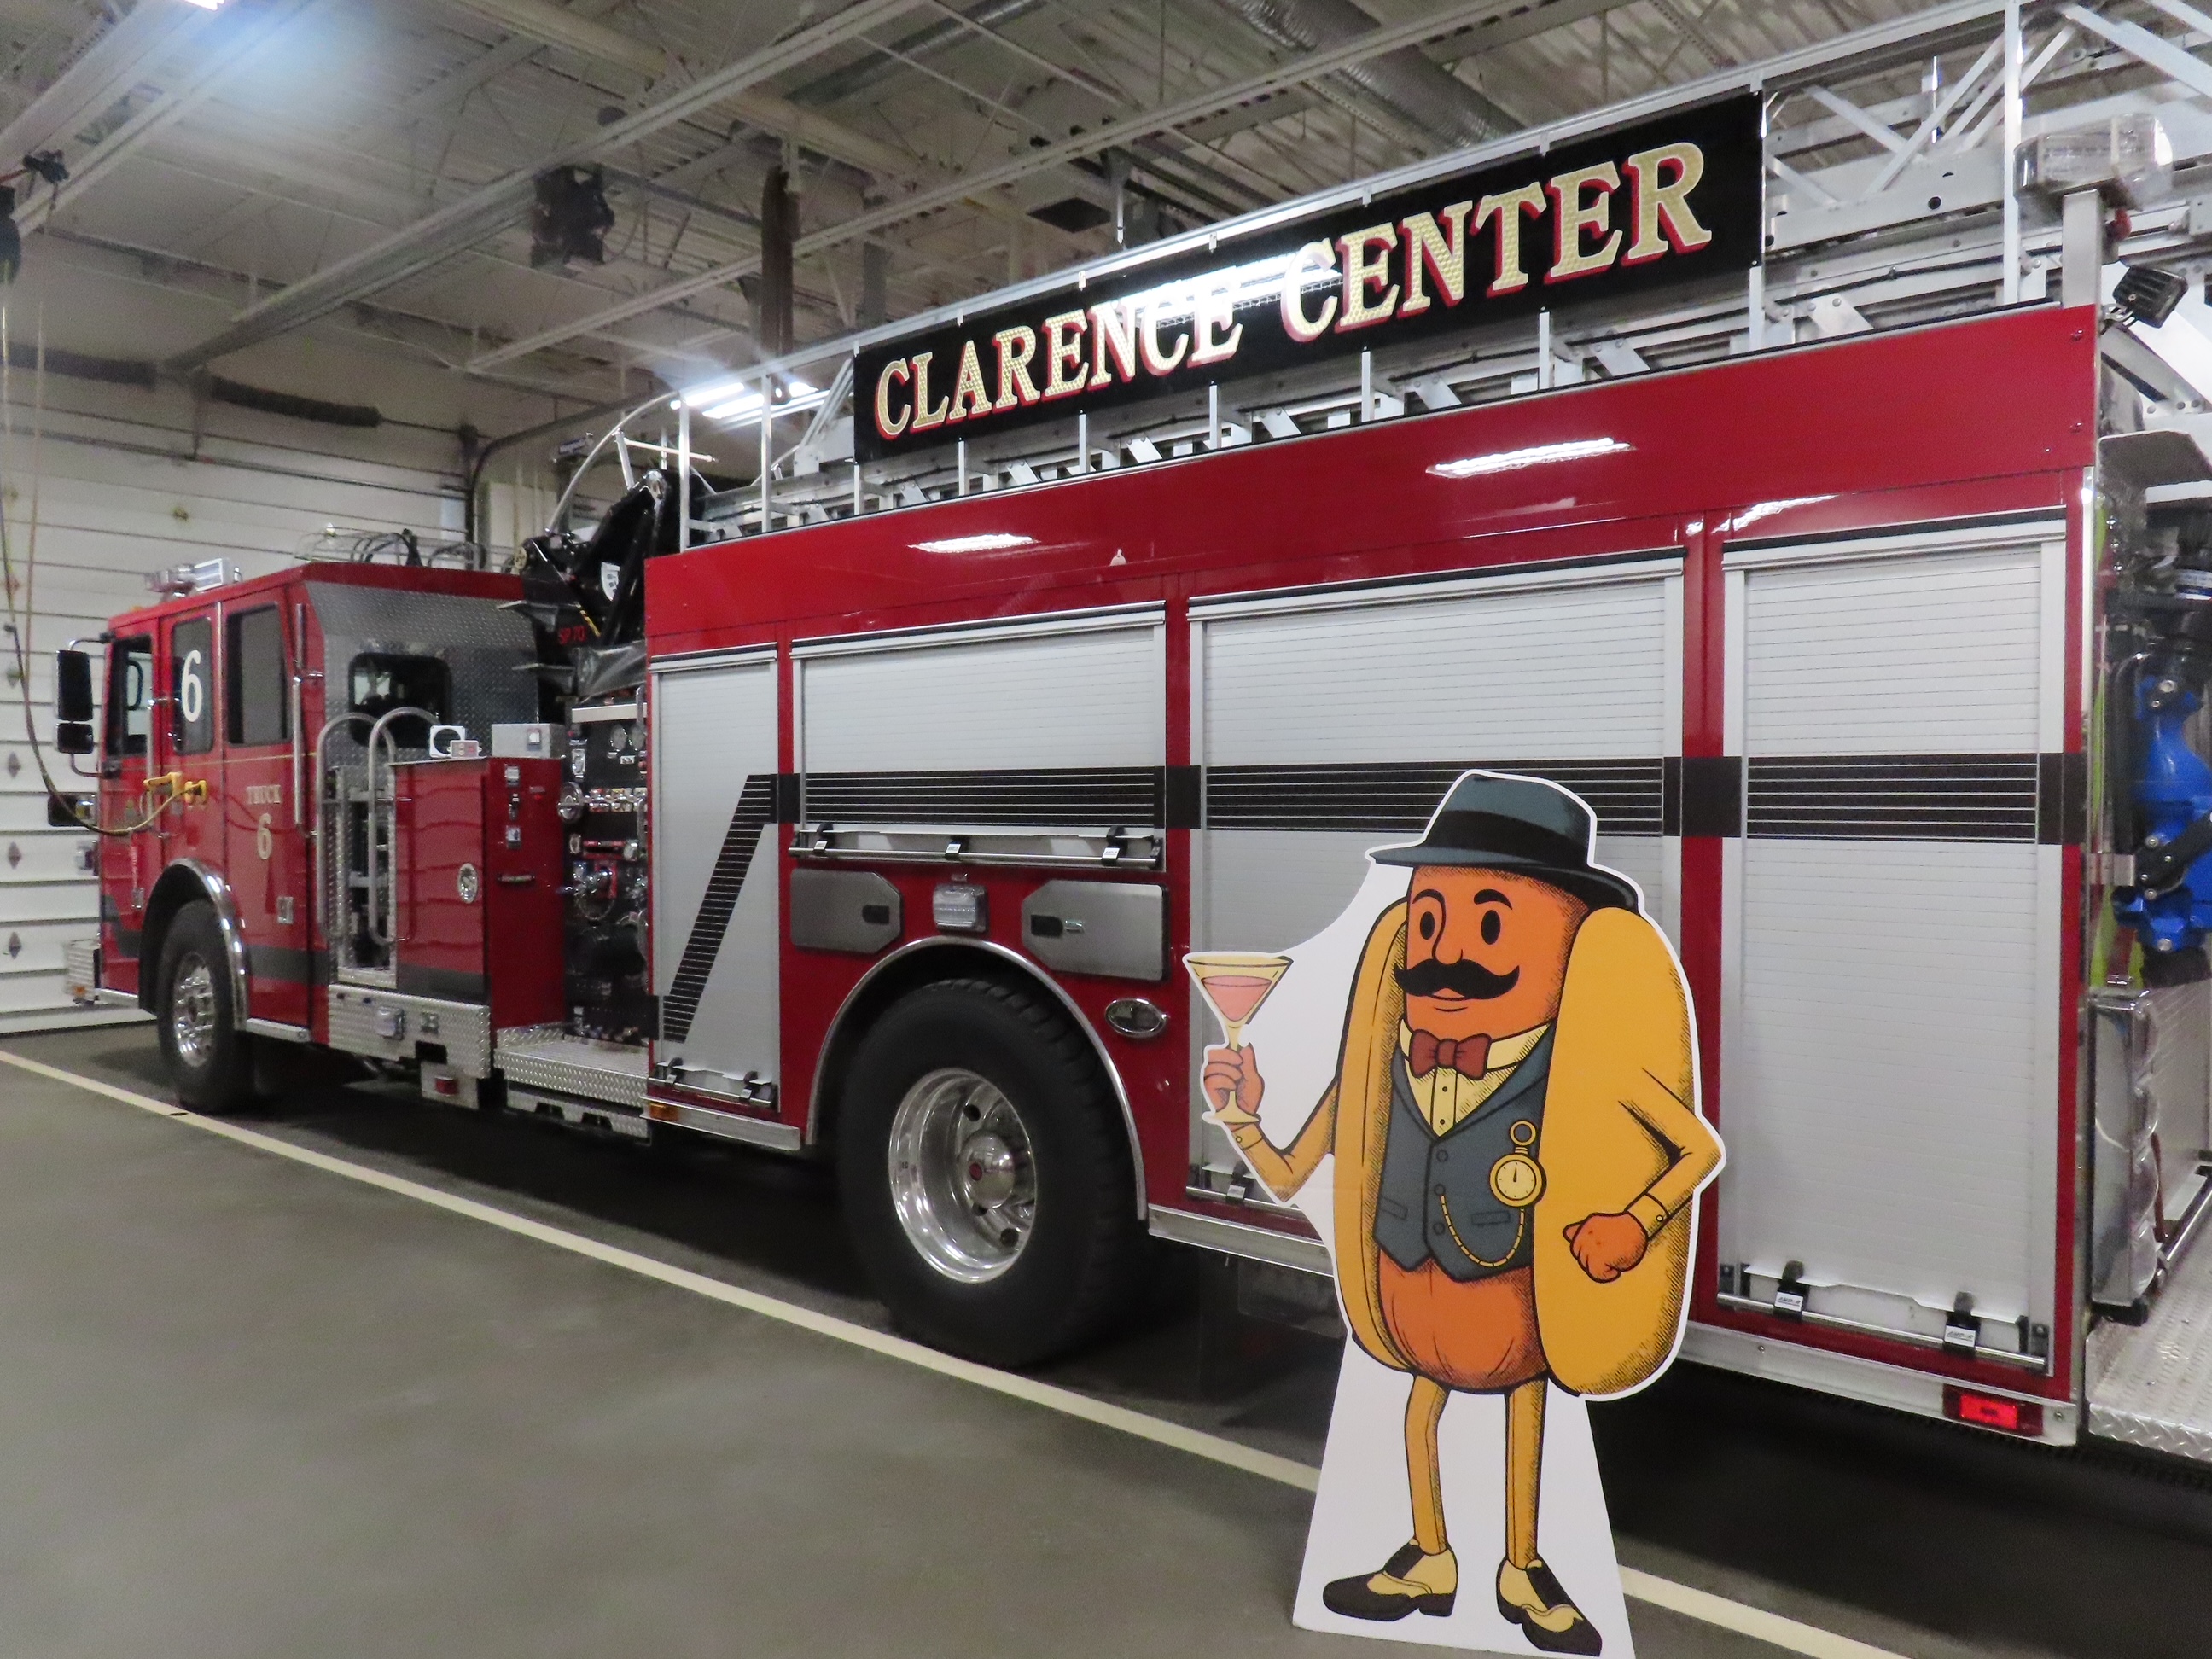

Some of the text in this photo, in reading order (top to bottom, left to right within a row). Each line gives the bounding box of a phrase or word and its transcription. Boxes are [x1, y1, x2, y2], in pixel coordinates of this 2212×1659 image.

[875, 142, 1712, 440] CLARENCE CENTER
[182, 649, 202, 722] 6
[246, 784, 282, 804] TRUCK
[256, 812, 273, 860] 6
